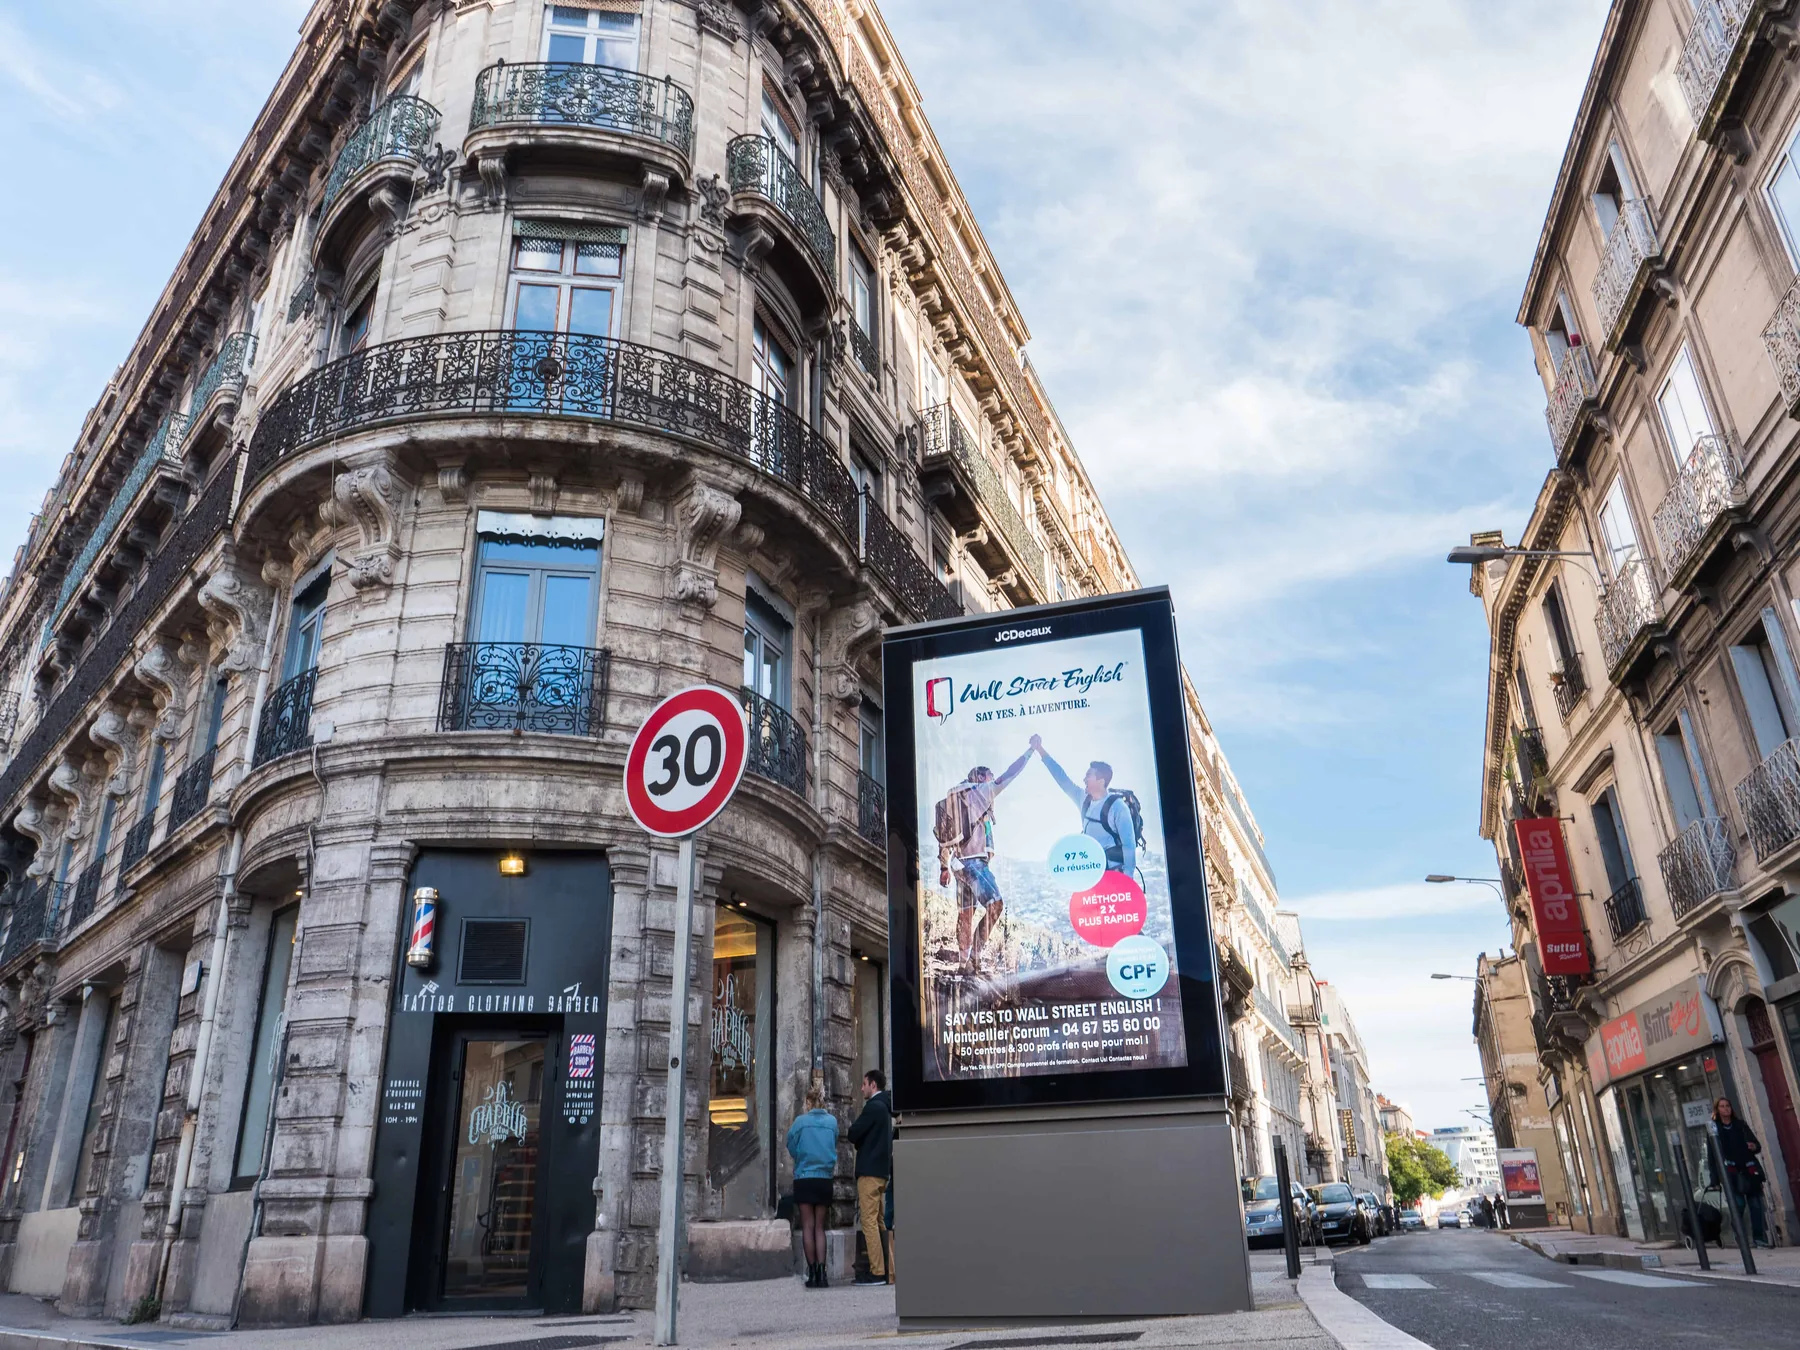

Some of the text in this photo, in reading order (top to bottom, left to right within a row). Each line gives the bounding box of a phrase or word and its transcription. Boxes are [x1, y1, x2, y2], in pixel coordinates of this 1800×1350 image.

[995, 625, 1052, 642] JCDecaux
[959, 662, 1124, 703] Wall Street English
[976, 699, 1090, 722] SAY YES. À L'AVENTURE.
[647, 724, 722, 796] 30
[1064, 851, 1088, 861] 97 %
[1053, 860, 1101, 873] de réussite
[1526, 830, 1573, 921] aprilia
[1082, 892, 1132, 905] MÉTHODE
[1100, 905, 1116, 914] 2 X
[1078, 913, 1140, 927] PLUS RAPIDE
[1546, 942, 1580, 954] Suttel
[1120, 963, 1156, 980] CPF
[403, 994, 599, 1013] TATTOO CLOTHING BARBER
[945, 1012, 968, 1027] SAY
[970, 1010, 993, 1025] YES
[997, 1009, 1013, 1023] TO
[1015, 1006, 1049, 1022] WALL
[1051, 1003, 1097, 1020] STREET
[1100, 999, 1153, 1016] ENGLISH
[943, 1026, 1010, 1045] Montpellier
[1013, 1025, 1050, 1041] Corum
[1062, 1022, 1080, 1037] 04
[1082, 1020, 1098, 1036] 67
[1102, 1019, 1119, 1034] 55
[1123, 1017, 1140, 1032] 60
[1143, 1016, 1161, 1031] 00
[573, 1044, 593, 1056] BARBER
[961, 1047, 972, 1056] 50
[974, 1046, 1006, 1056] centres
[1008, 1044, 1015, 1053] &
[1017, 1043, 1035, 1053] 300
[1037, 1040, 1060, 1053] profs
[1062, 1040, 1080, 1050] rien
[1081, 1041, 1099, 1050] que
[1101, 1037, 1124, 1049] pour
[1125, 1036, 1143, 1046] moi
[1606, 1019, 1642, 1070] aprilia
[575, 1056, 590, 1066] SHOP
[1025, 1060, 1049, 1068] personnel
[565, 1080, 595, 1089] CONTACT
